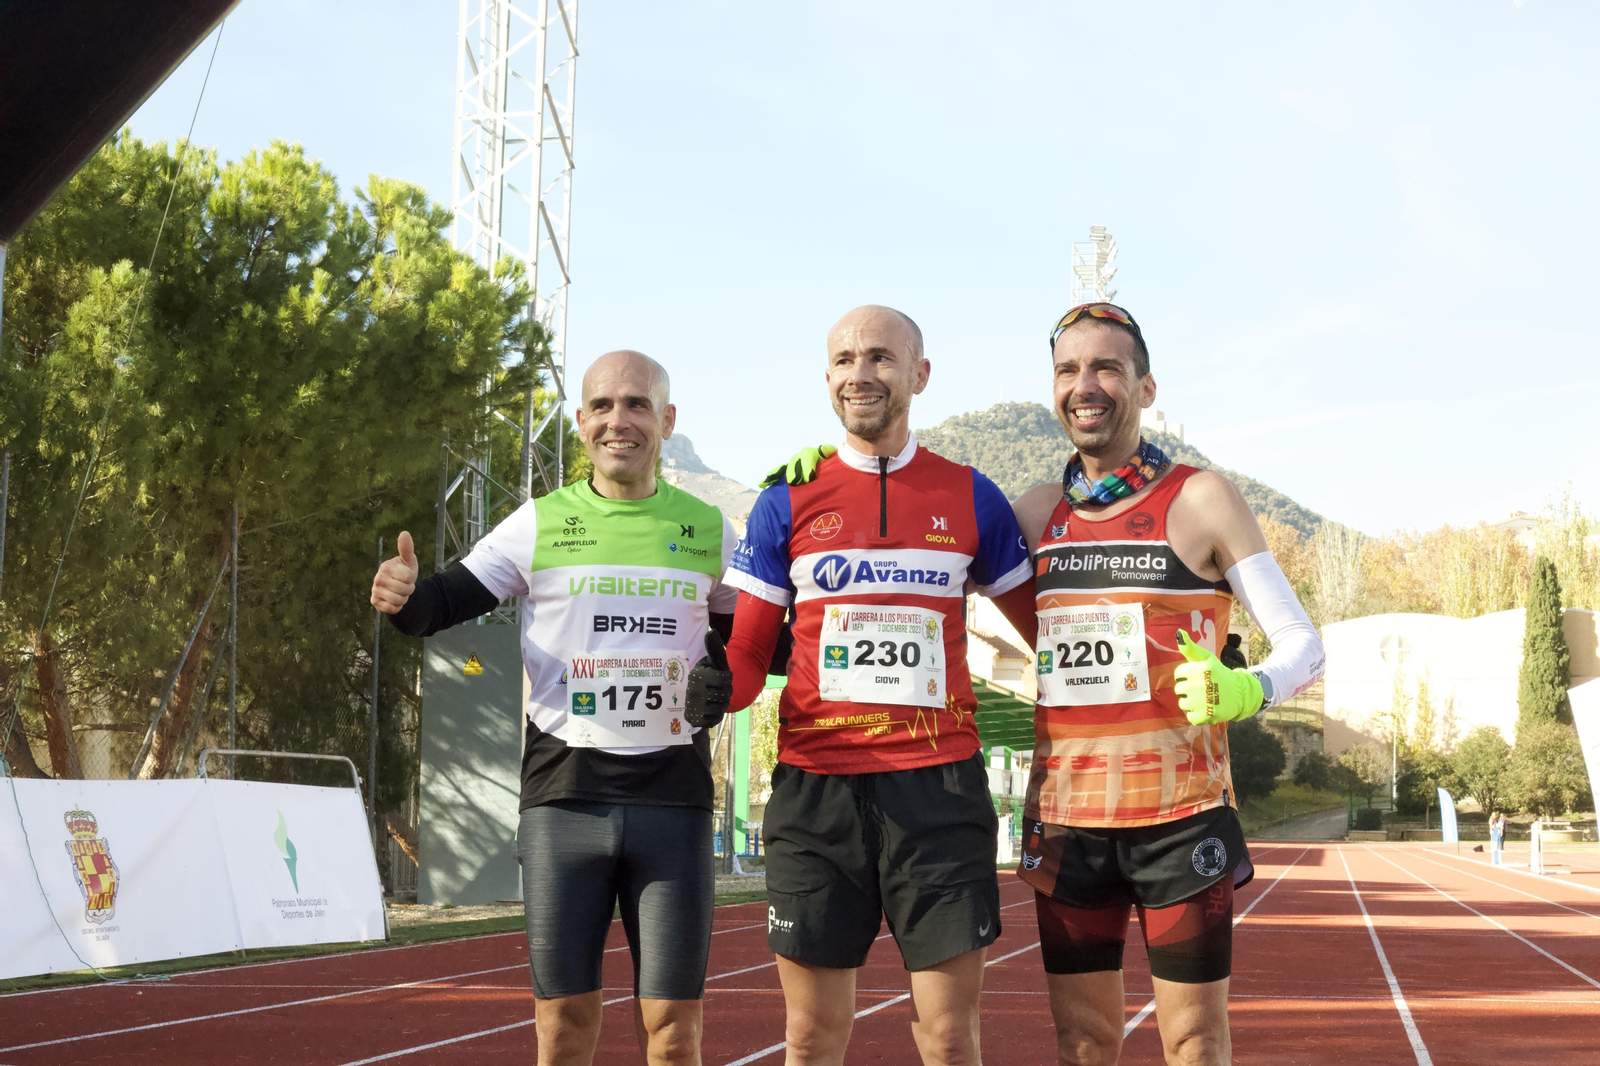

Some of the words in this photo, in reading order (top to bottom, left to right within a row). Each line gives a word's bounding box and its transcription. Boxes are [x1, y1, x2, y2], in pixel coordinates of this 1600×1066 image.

[925, 534, 956, 544] GIOVA
[1049, 553, 1167, 572] PubliPrenda
[853, 560, 950, 586] Avanza
[1111, 570, 1166, 581] Promowear
[851, 612, 878, 622] CARRERA
[879, 613, 884, 622] A
[885, 614, 895, 623] LOS
[897, 614, 921, 624] PUENTES
[1051, 615, 1071, 625] CARRERA
[1076, 613, 1084, 623] LOS
[1085, 613, 1109, 622] PUENTES
[852, 622, 864, 631] JAÉN
[882, 624, 907, 633] DICIEMBRE
[909, 625, 921, 634] 2023
[1074, 625, 1096, 633] DICIEMBRE
[1097, 624, 1109, 632] 2023
[854, 640, 921, 668] 230
[1057, 640, 1114, 668] 220
[572, 659, 595, 678] XXV
[597, 659, 622, 668] CARRERA
[623, 659, 627, 668] A
[628, 659, 639, 668] LOS
[640, 658, 662, 668] PUENTES
[598, 668, 609, 677] JAÉN
[626, 669, 650, 677] DICIEMBRE
[651, 669, 662, 677] 2023
[875, 676, 900, 684] GIOVA
[1065, 676, 1110, 686] VALENZUELA
[1204, 670, 1213, 704] ANIVERSARIO
[602, 685, 662, 710] 175
[864, 726, 891, 736] JAEN
[271, 899, 296, 907] Patronato
[296, 897, 321, 907] Municipal
[281, 910, 305, 920] Deportes
[305, 909, 313, 918] de
